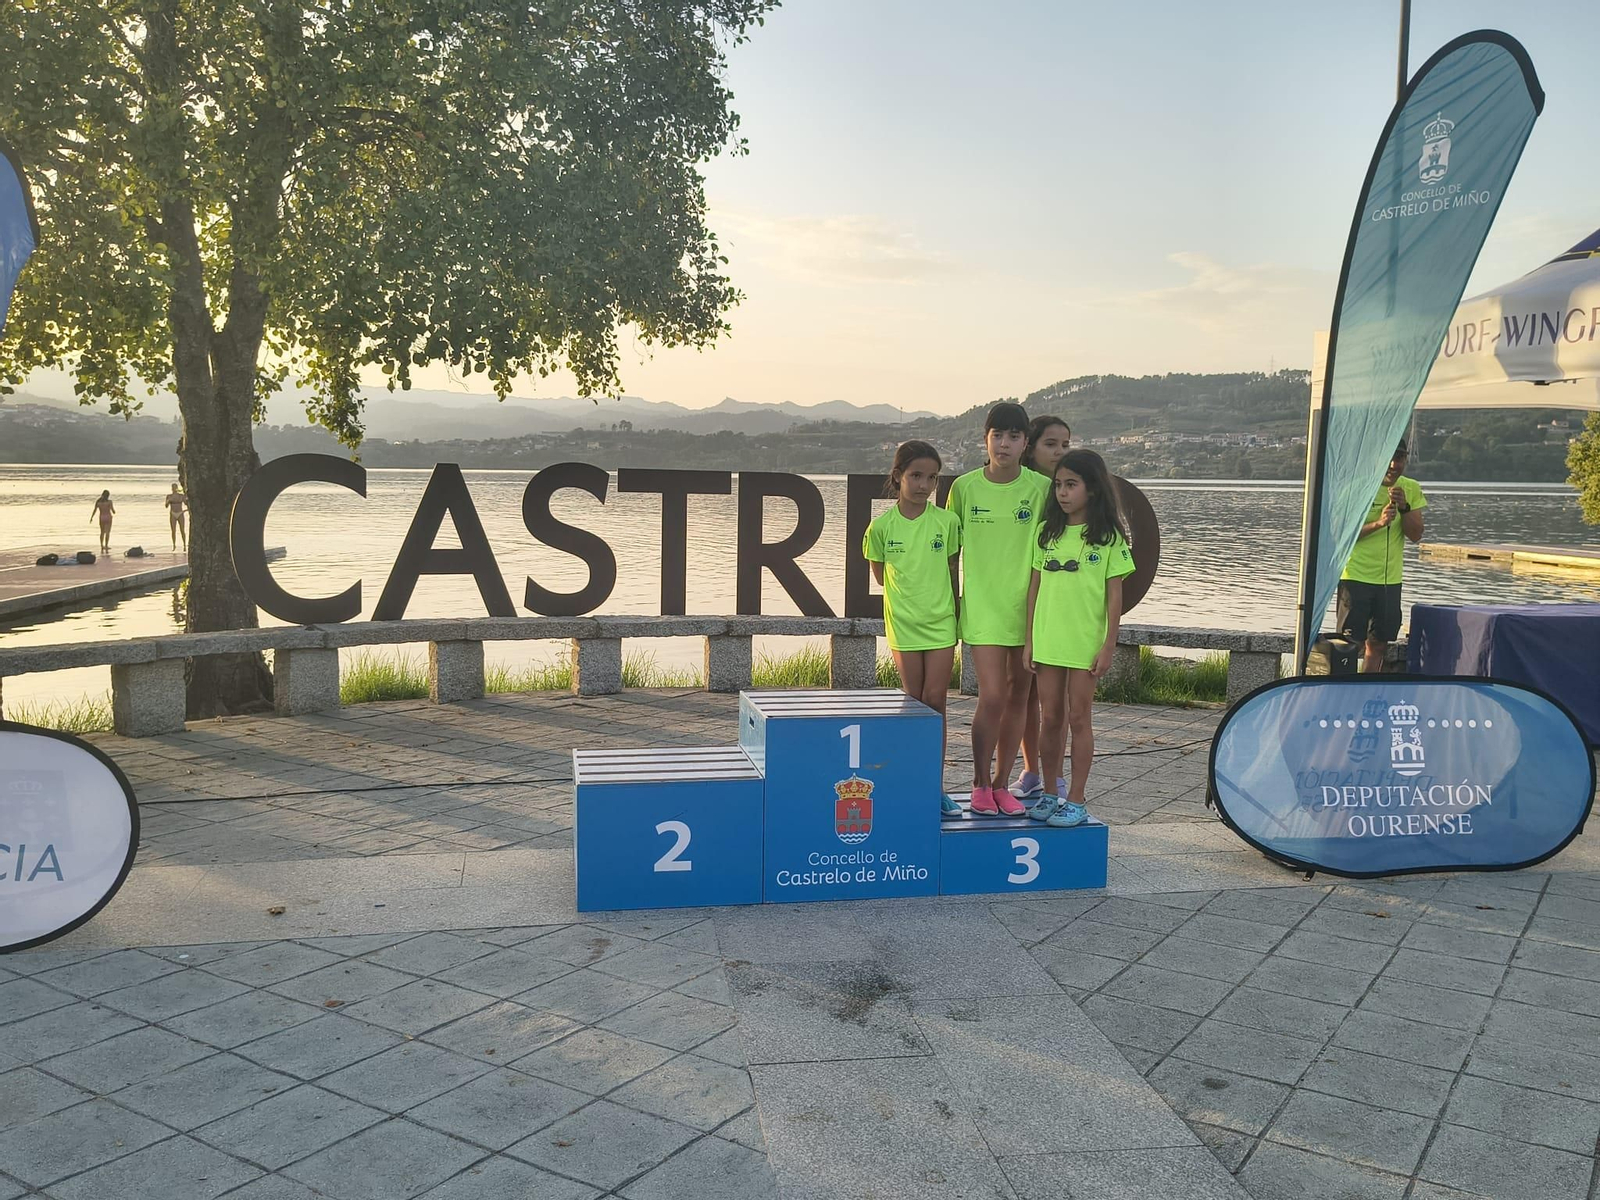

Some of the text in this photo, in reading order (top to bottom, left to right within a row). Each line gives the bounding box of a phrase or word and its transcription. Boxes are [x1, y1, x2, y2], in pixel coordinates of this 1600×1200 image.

[1371, 189, 1490, 222] CASTRELO DE MIÑO
[1400, 183, 1462, 203] CONCELLO DE
[839, 724, 862, 769] 1
[1320, 778, 1493, 808] DEPUTACIÓN
[1347, 813, 1474, 838] OURENSE
[653, 820, 693, 873] 2
[808, 849, 898, 866] Concello de
[1006, 837, 1041, 885] 3
[776, 864, 928, 886] Castrelo de Miño
